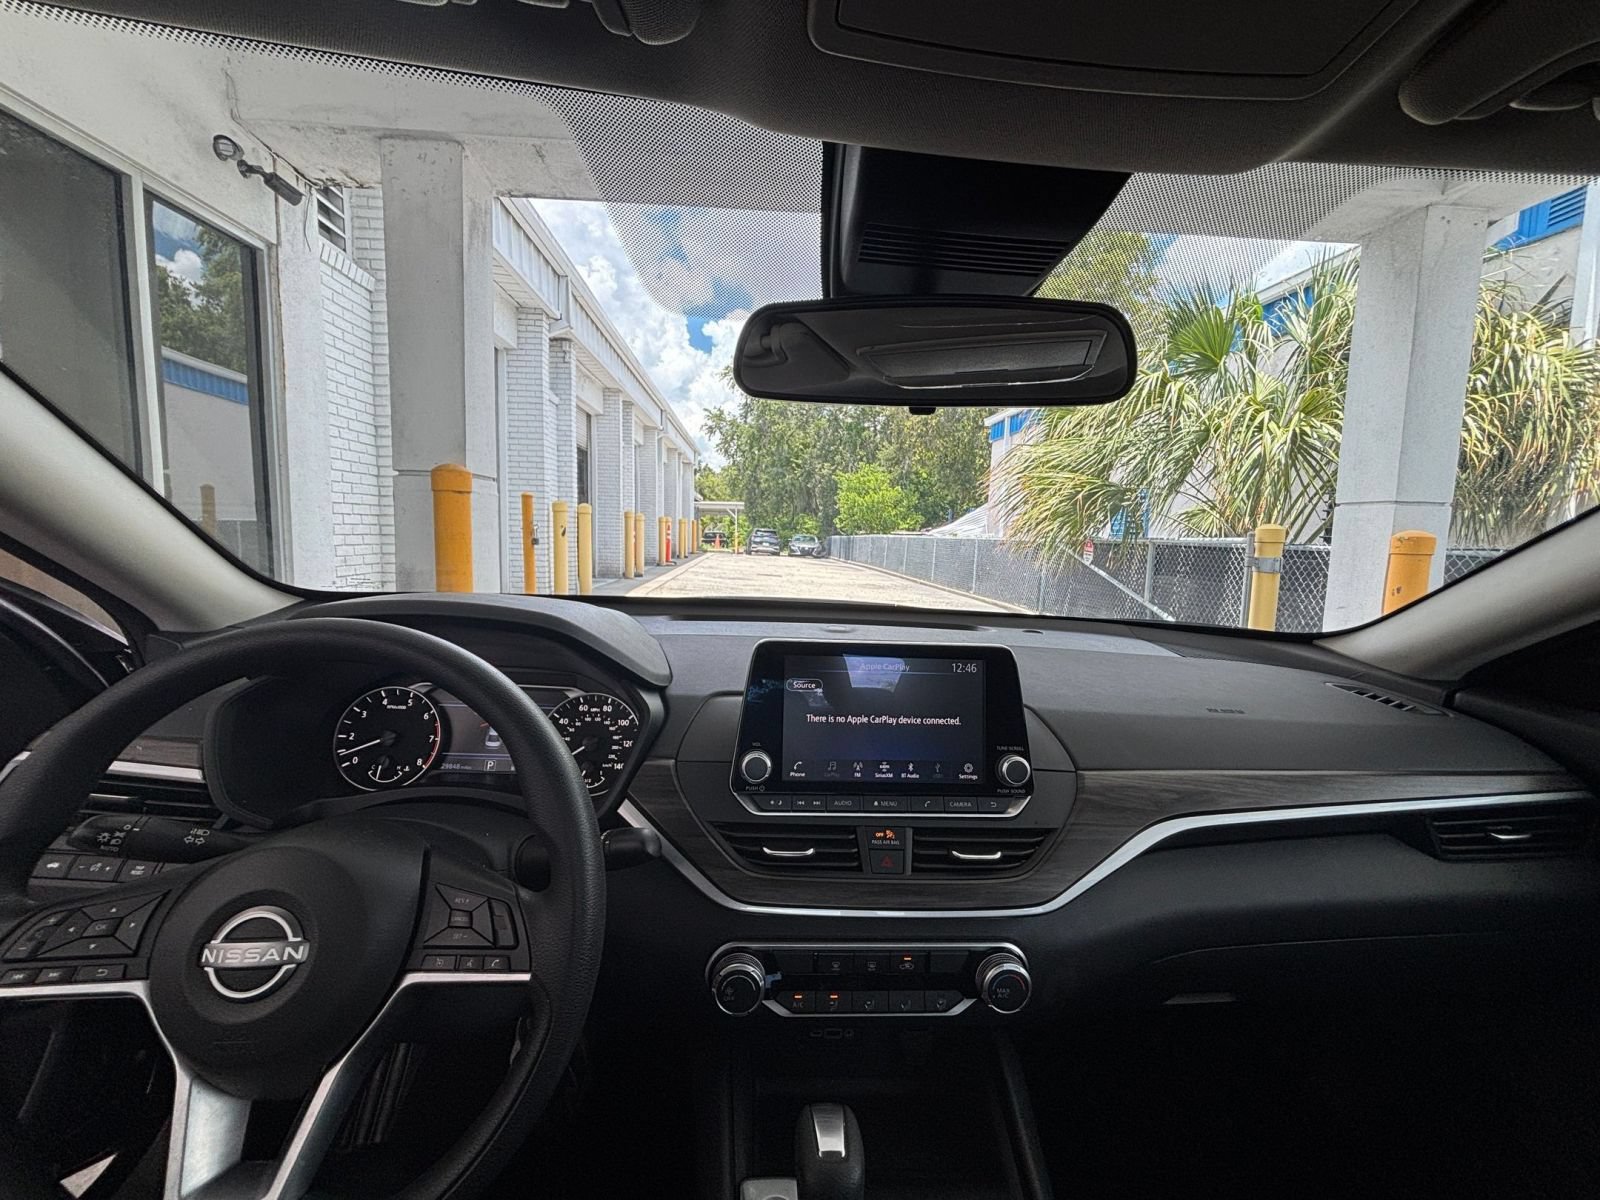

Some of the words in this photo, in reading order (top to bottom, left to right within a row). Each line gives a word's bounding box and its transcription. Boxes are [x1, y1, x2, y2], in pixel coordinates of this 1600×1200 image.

[861, 663, 882, 672] Apple
[883, 663, 910, 672] CarPlay
[951, 663, 978, 673] 12:46
[793, 681, 816, 690] Source
[382, 698, 388, 706] 4
[806, 714, 826, 722] There
[828, 714, 835, 723] is
[847, 715, 869, 725] Apple
[870, 715, 898, 726] CarPlay
[898, 716, 922, 725] device
[922, 716, 962, 726] connected.
[429, 735, 434, 743] 7
[352, 756, 358, 764] 0
[416, 758, 422, 766] 8
[487, 760, 495, 772] P
[958, 773, 978, 781] Settings
[201, 945, 305, 964] NISSAN
[791, 1001, 805, 1009] A/C
